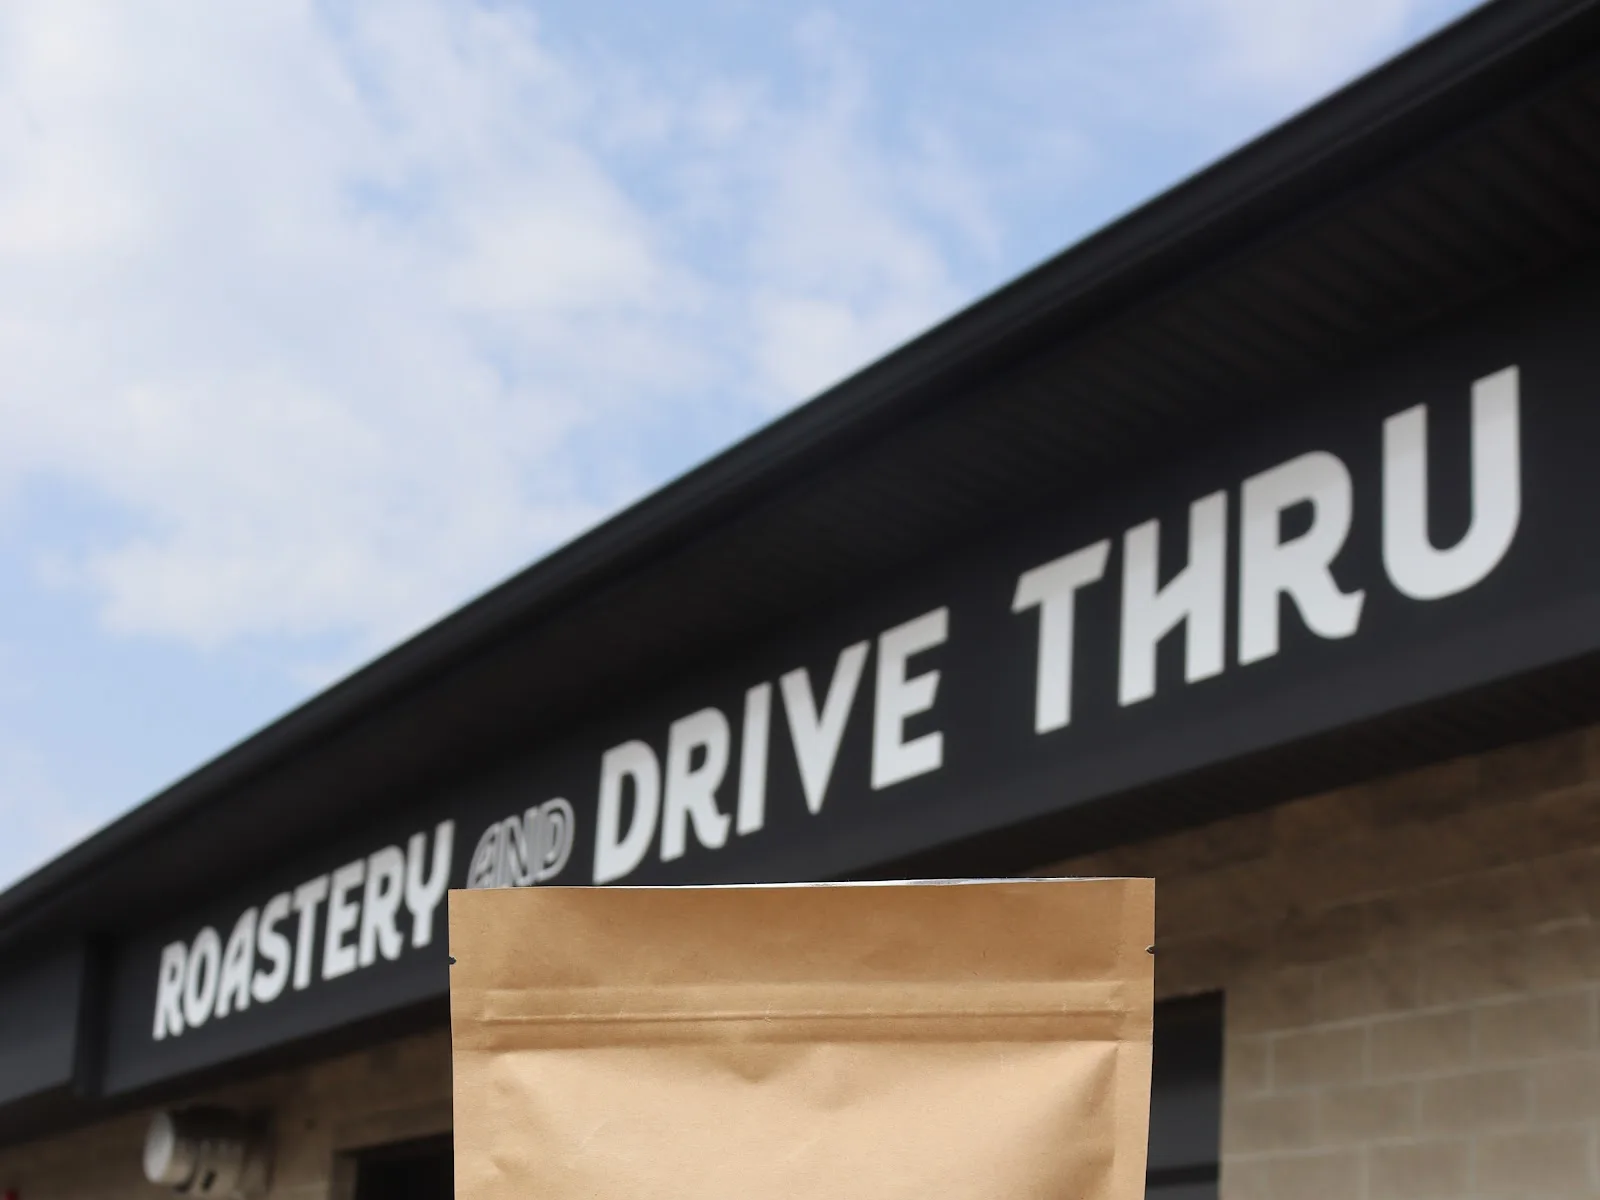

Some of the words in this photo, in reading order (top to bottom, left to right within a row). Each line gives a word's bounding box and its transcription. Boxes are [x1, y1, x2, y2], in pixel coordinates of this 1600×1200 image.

[152, 820, 455, 1041] ROASTERY
[594, 606, 950, 884] DRIVE
[1011, 364, 1522, 736] THRU
